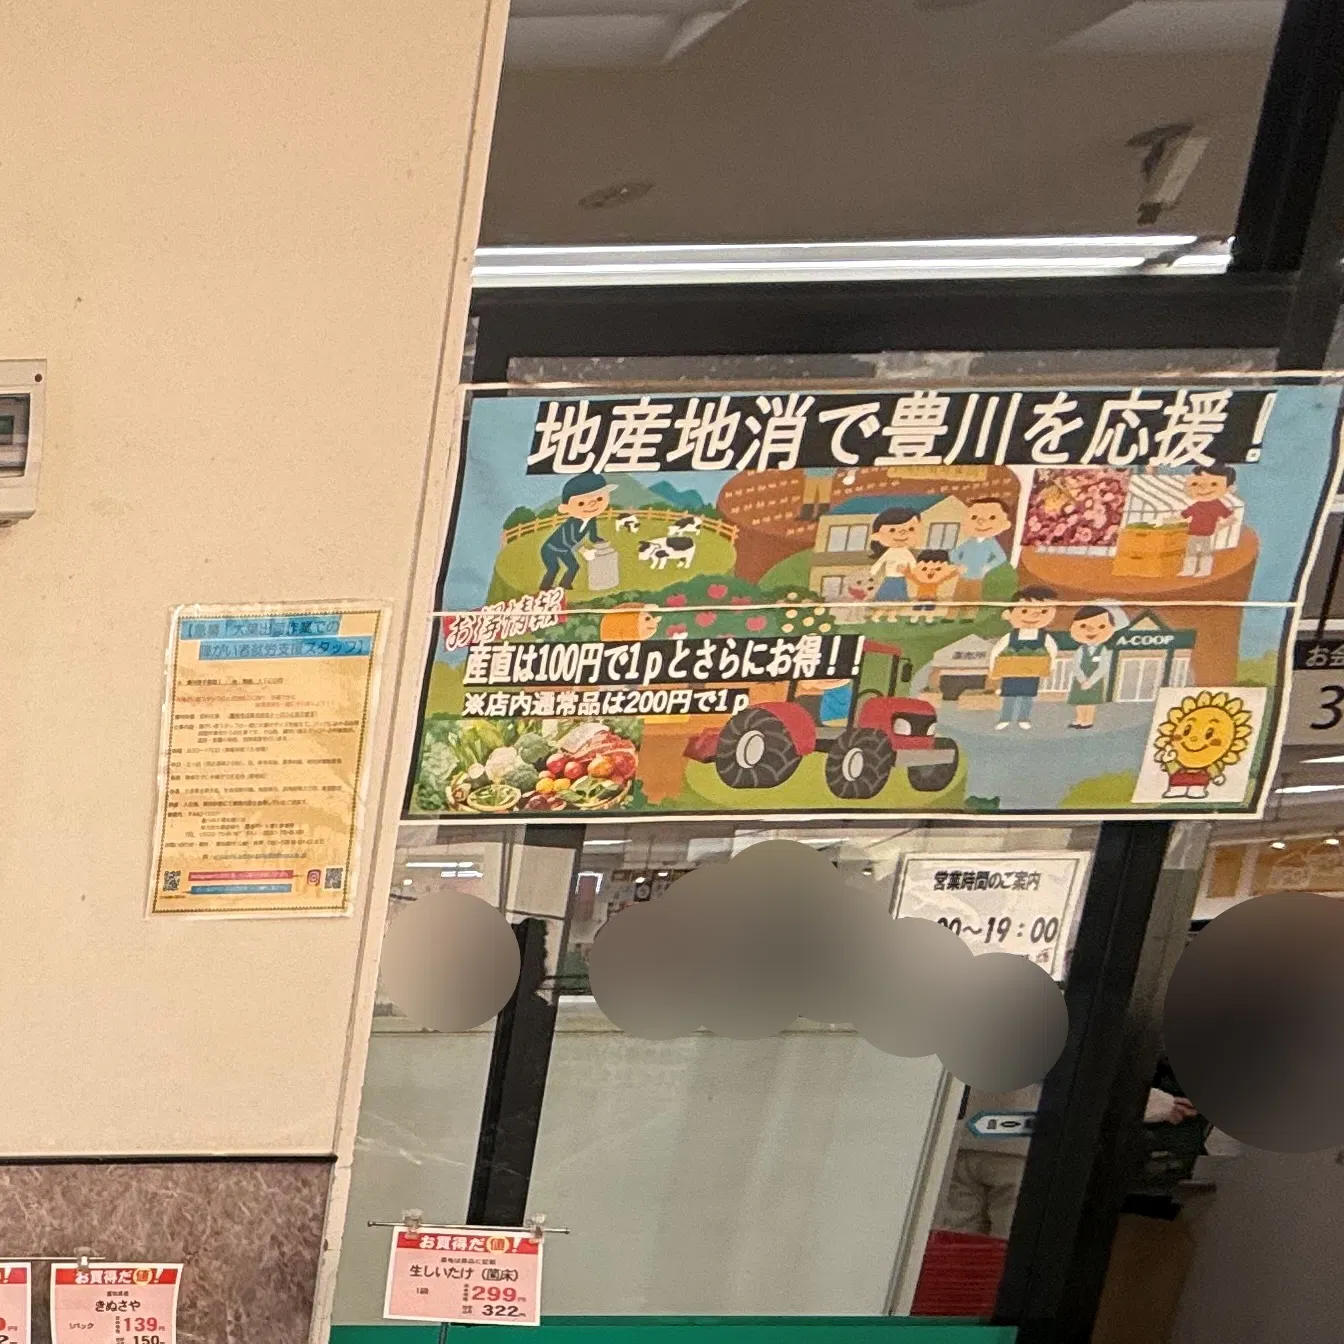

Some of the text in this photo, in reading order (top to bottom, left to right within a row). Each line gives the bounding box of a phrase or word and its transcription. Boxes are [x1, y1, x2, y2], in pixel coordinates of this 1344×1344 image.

[527, 389, 1278, 474] 地産地消で豊川を応援！
[1115, 633, 1176, 647] A-COOP
[933, 870, 1042, 891] 営業時間のご案内
[95, 1299, 142, 1313] きぬさや
